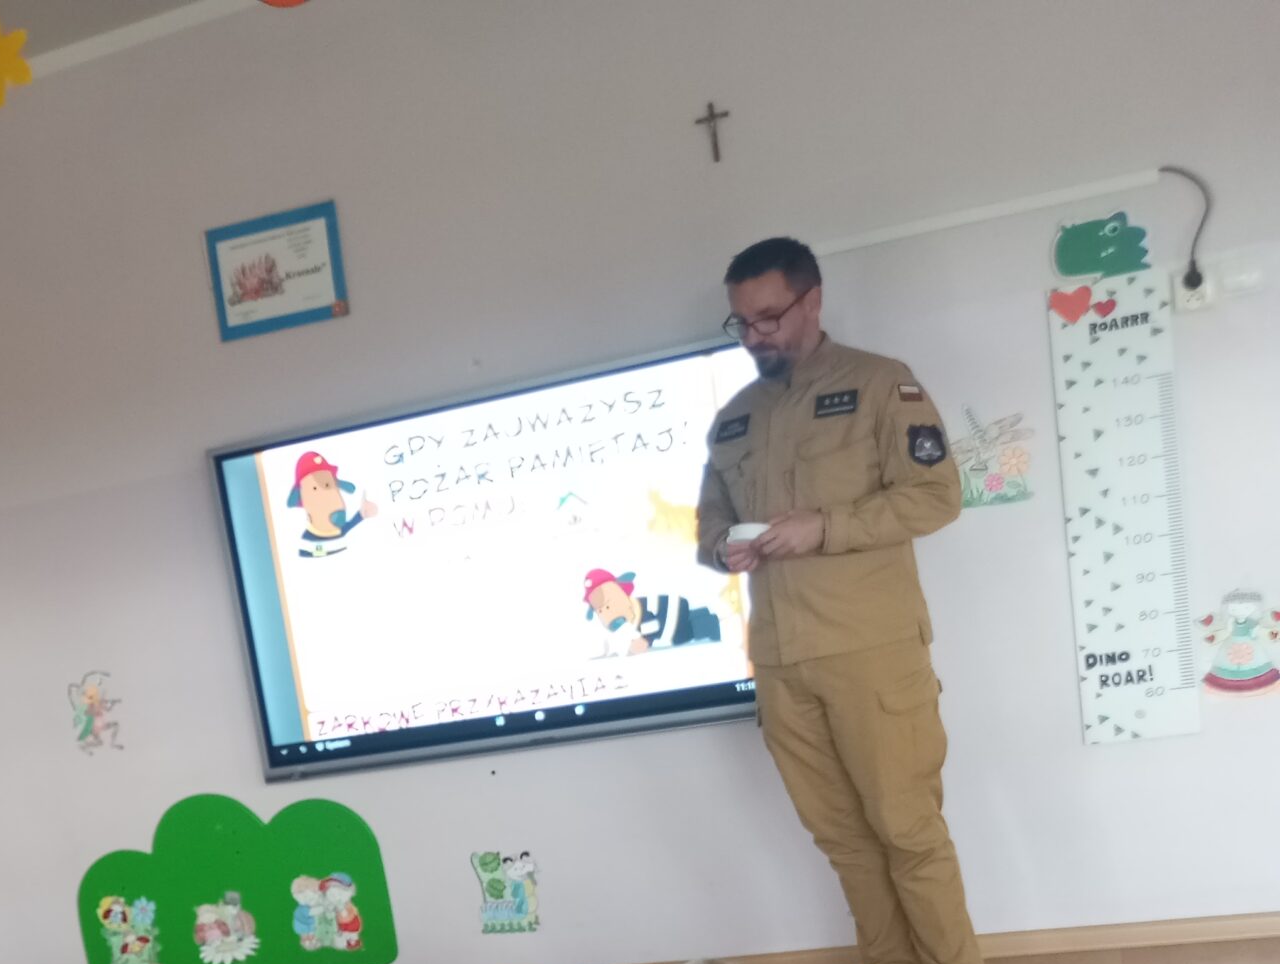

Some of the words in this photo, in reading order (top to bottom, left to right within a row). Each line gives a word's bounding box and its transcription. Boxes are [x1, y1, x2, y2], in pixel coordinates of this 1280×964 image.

[1089, 312, 1149, 335] ROARRR
[1113, 373, 1141, 387] 140
[1115, 413, 1144, 427] 130
[1118, 453, 1147, 467] 120
[388, 461, 495, 503] POŻAR
[1122, 493, 1150, 507] 110
[1124, 533, 1153, 546] 100
[1136, 571, 1156, 584] 90
[1138, 609, 1159, 622] 80
[1141, 647, 1162, 659] 70
[1085, 651, 1130, 671] DINO
[1099, 664, 1153, 690] ROAR!
[1144, 686, 1166, 698] 60
